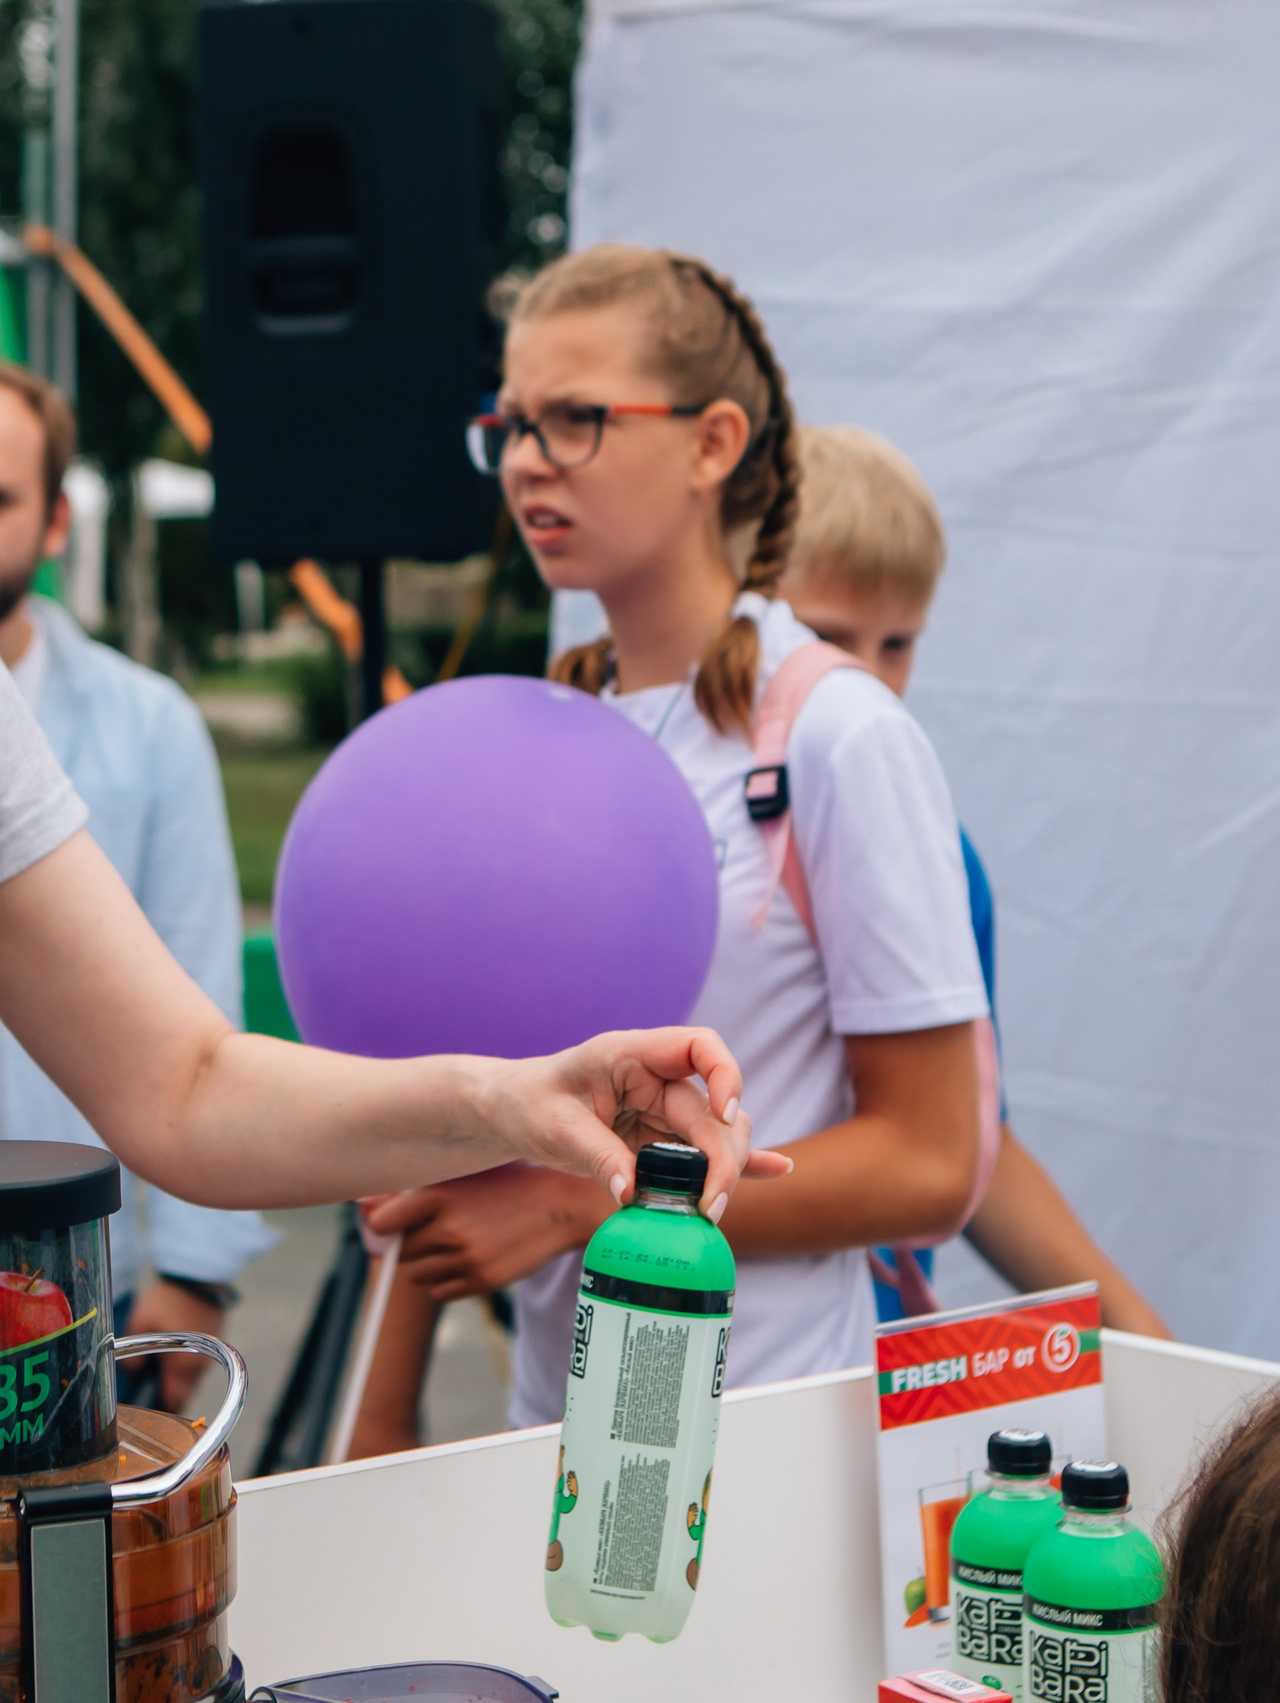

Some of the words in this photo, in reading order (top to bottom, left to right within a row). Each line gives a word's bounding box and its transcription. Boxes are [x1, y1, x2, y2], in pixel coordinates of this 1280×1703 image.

[891, 1355, 968, 1394] FRESH
[972, 1347, 1010, 1379] БАР
[958, 1565, 997, 1584] КИСЛЫЙ
[997, 1570, 1023, 1587] МИК
[1032, 1602, 1072, 1624] КИСЛЫЙ
[1072, 1612, 1104, 1628] МИКС
